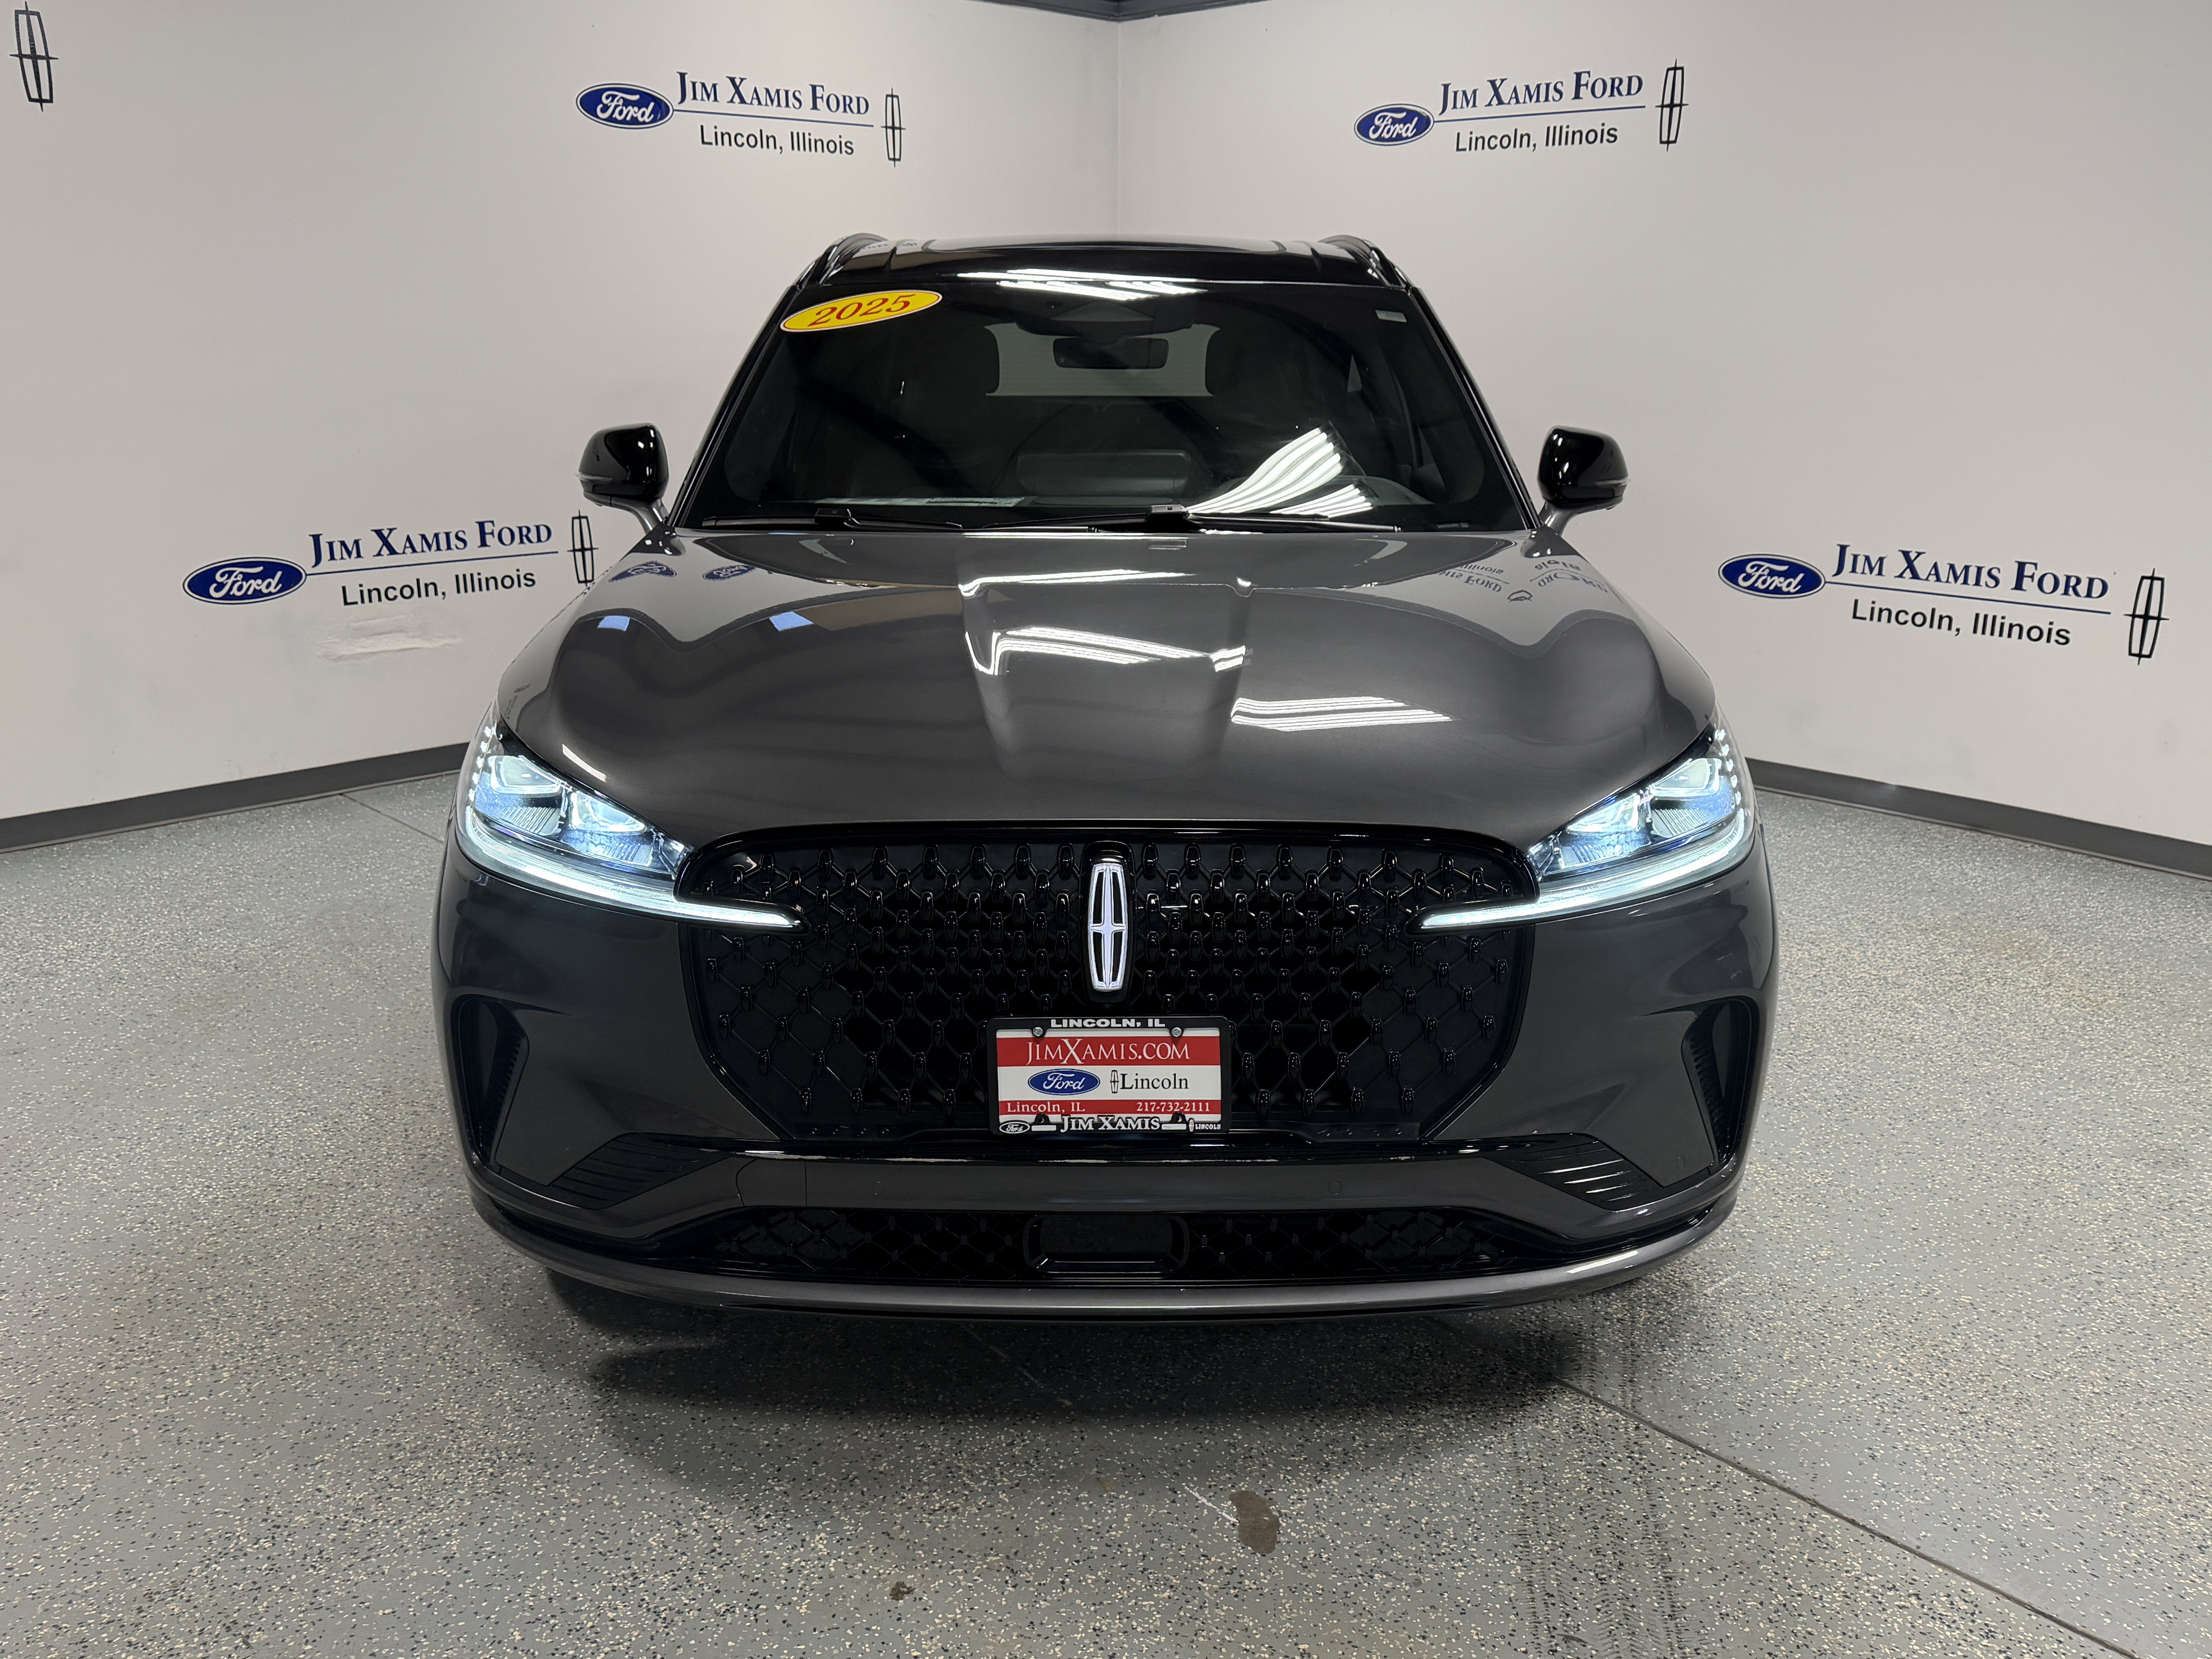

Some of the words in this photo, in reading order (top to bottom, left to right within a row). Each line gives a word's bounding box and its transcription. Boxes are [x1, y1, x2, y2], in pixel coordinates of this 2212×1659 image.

[597, 91, 654, 122] Ford
[676, 71, 719, 105] JIM
[725, 76, 802, 109] XAMIS
[809, 84, 869, 115] FORD
[1439, 83, 1479, 116] JIM
[1485, 78, 1564, 107] XAMIS
[1571, 70, 1644, 101] FORD
[700, 125, 783, 154] Lincoln,
[790, 131, 854, 155] Illinois
[1369, 112, 1417, 139] Ford
[1456, 128, 1537, 152] Lincoln,
[1545, 122, 1618, 147] Illinois
[807, 294, 916, 327] 2025
[308, 533, 364, 568] JIM
[370, 527, 468, 558] XAMIS
[474, 520, 552, 548] FORD
[209, 567, 282, 598] Ford
[1739, 562, 1802, 594] Ford
[1831, 544, 1886, 577] JIM
[1894, 549, 2001, 589] XAMIS
[2010, 560, 2109, 599] FORD
[341, 577, 446, 606] Lincoln,
[455, 568, 536, 594] Illinois
[1851, 599, 1961, 637] Lincoln,
[1972, 613, 2071, 646] Illinois
[1050, 1018, 1142, 1029] LINCOLN,
[1148, 1018, 1166, 1027] IL
[1026, 1038, 1191, 1066] JIMXAMIS.COM
[1043, 1070, 1086, 1090] Ford
[1120, 1073, 1189, 1090] Lincoln
[1006, 1102, 1066, 1114] Lincoln,
[1070, 1102, 1086, 1112] IL
[1136, 1102, 1210, 1112] 217-732-2111
[1060, 1116, 1094, 1133] JIM
[1097, 1116, 1160, 1130] XAMIS
